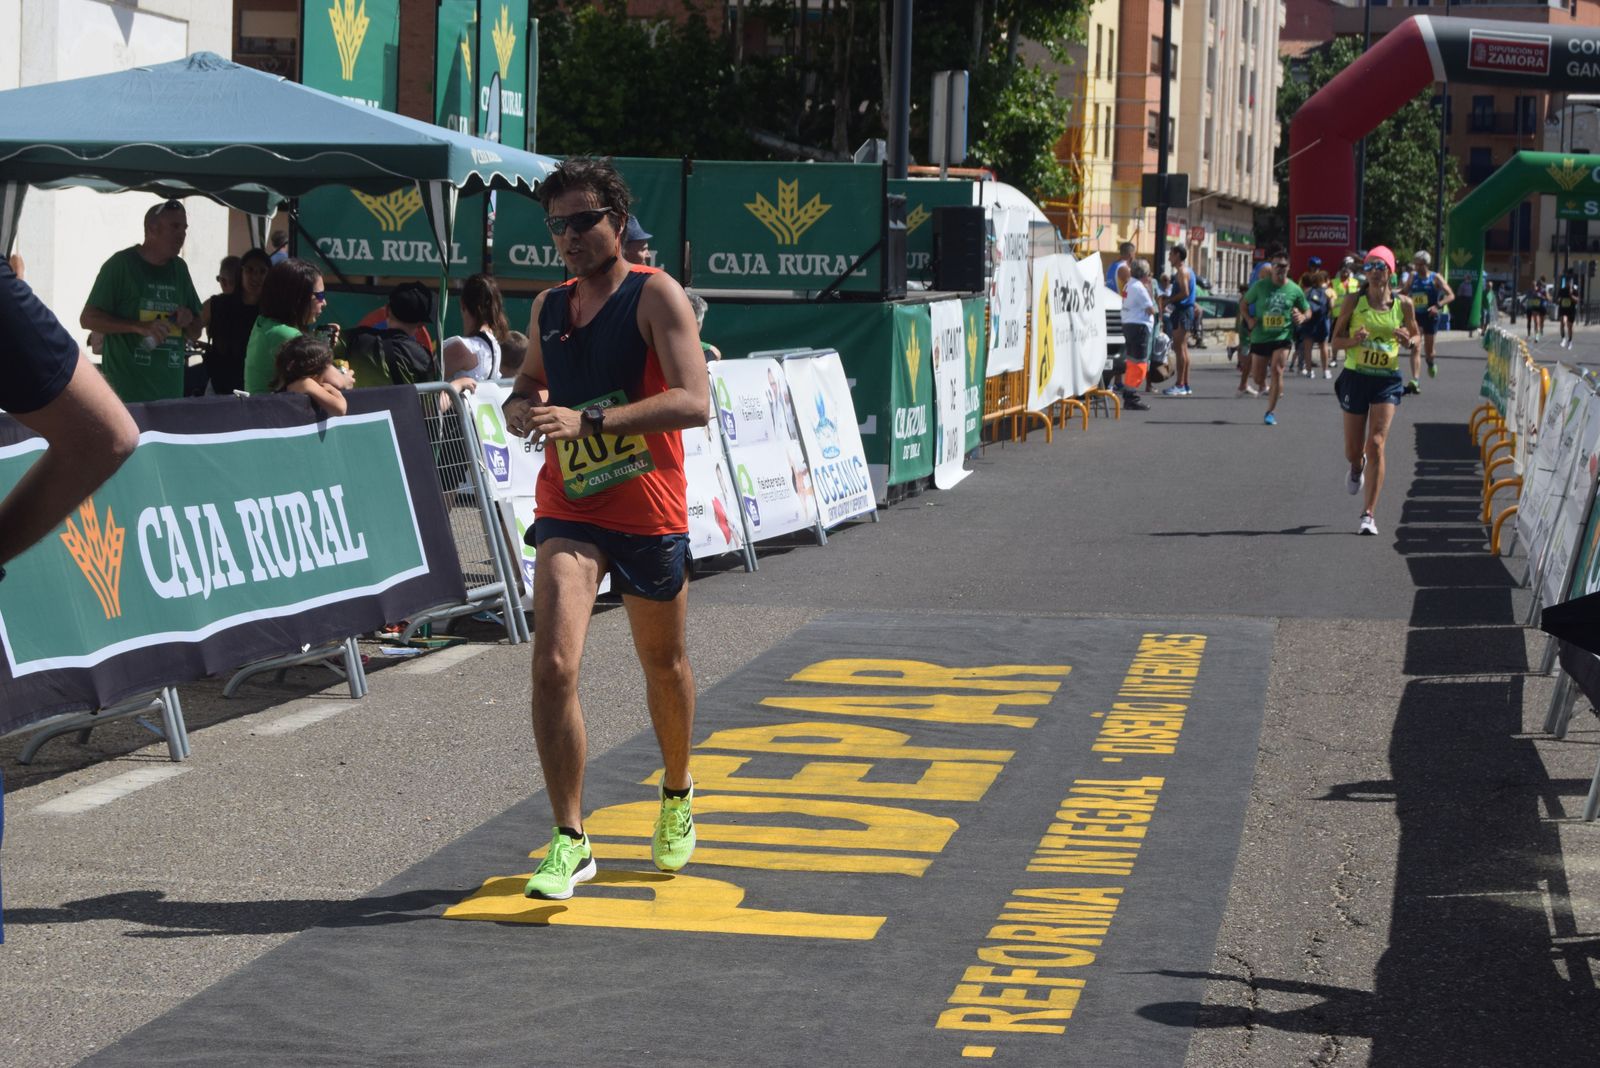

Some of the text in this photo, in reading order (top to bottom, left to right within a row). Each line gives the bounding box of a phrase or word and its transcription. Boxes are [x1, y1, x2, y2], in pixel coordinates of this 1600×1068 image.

[1487, 53, 1545, 68] ZAMORA
[1306, 231, 1347, 240] ZAMORA
[316, 237, 467, 264] CAJA RURAL
[708, 252, 867, 277] CAJA RURAL
[1363, 350, 1390, 367] 103
[563, 432, 636, 473] 202
[588, 458, 649, 487] CAJA RURAL
[813, 455, 869, 505] OCEANIC
[137, 483, 369, 601] CAJA RURAL
[935, 633, 1208, 1035] REFORMA INTEGRAL DISEÑO INTERIORES
